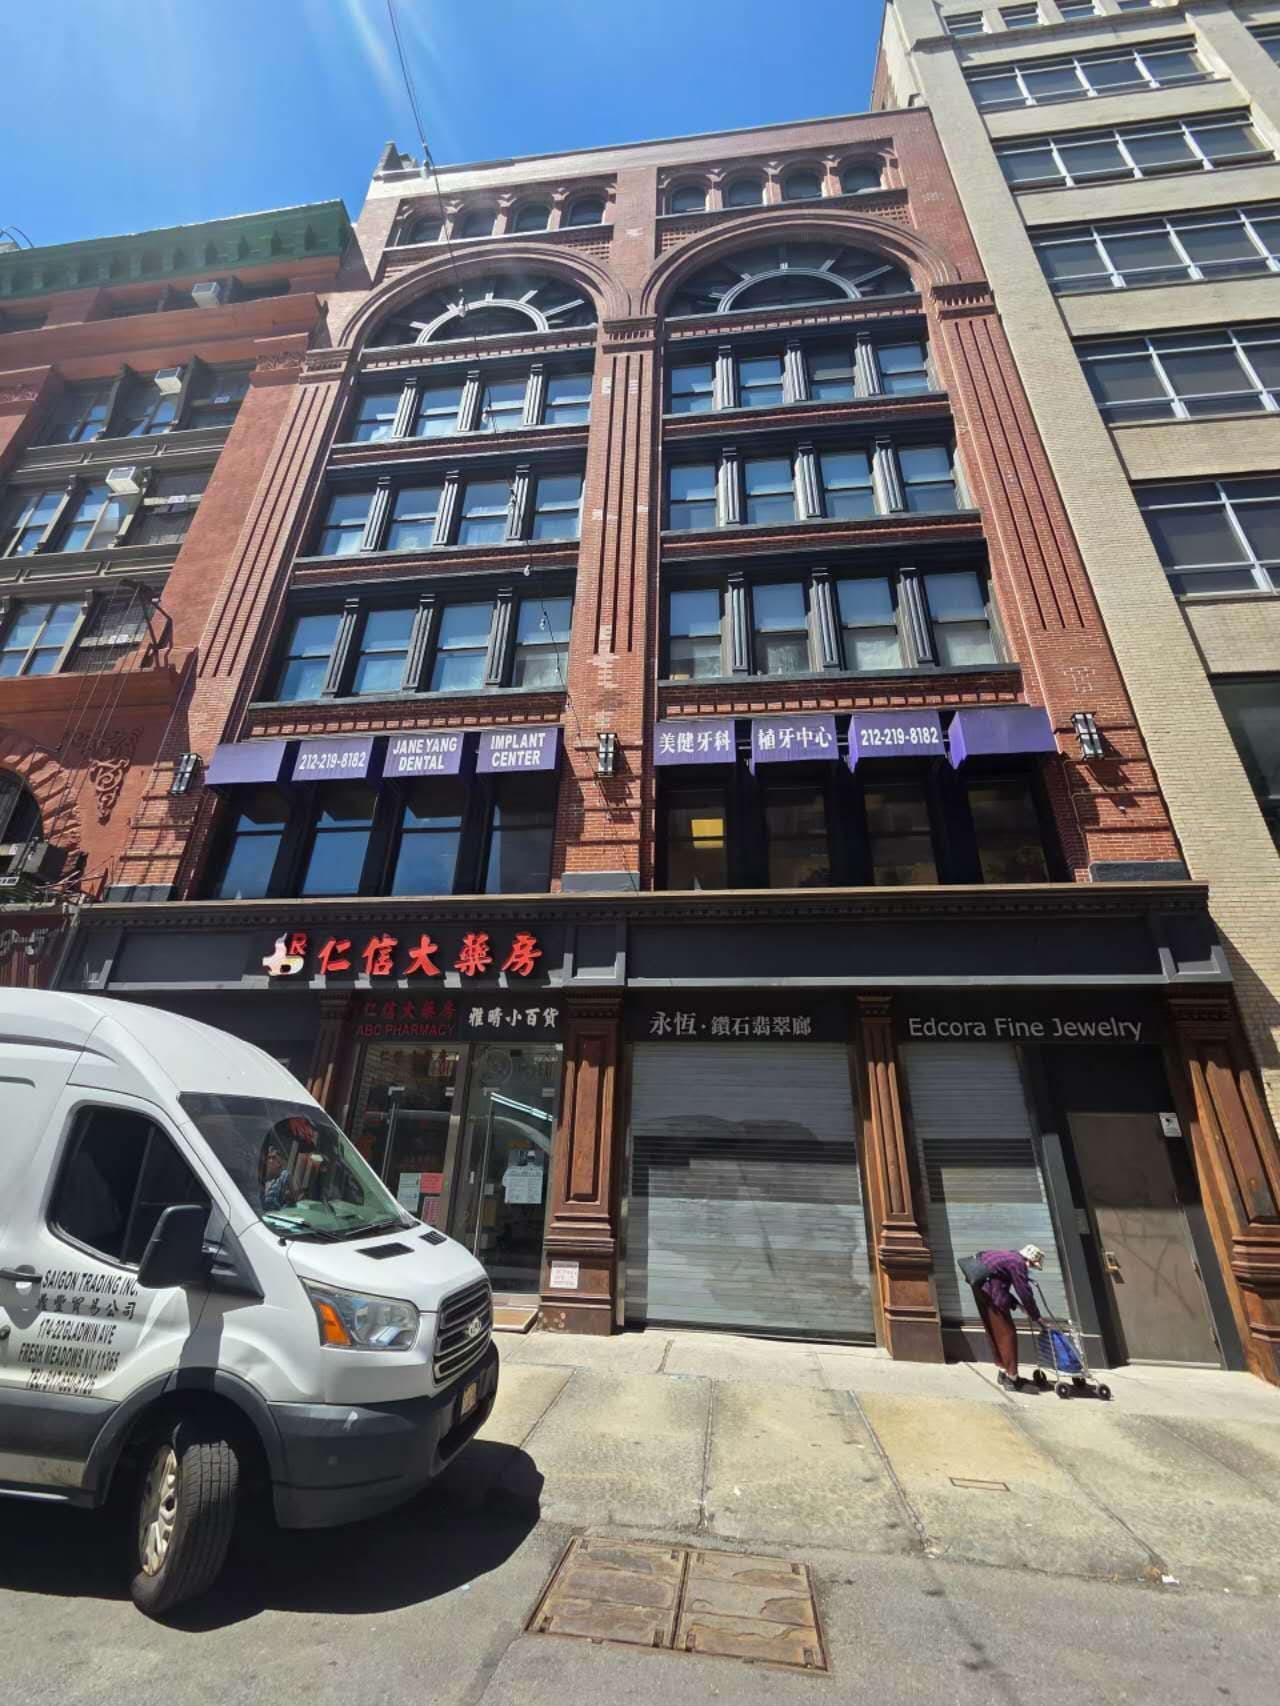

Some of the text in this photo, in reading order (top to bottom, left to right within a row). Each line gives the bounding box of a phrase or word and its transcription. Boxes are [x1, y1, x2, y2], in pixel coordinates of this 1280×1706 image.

[490, 733, 546, 750] IMPLANT
[659, 731, 731, 755] 美健牙科
[757, 726, 833, 750] 植牙中心
[860, 727, 940, 746] 212-219-8182
[392, 738, 458, 755] JANE YANG
[298, 751, 367, 770] 212-219-8182
[398, 756, 445, 771] DENTAL
[491, 751, 541, 768] CENTER
[317, 930, 544, 977] 仁信大藥房
[908, 1017, 1142, 1041] Edcora Fine Jewelry
[42, 1269, 79, 1290] SAIGON
[78, 1272, 122, 1295] TRADING
